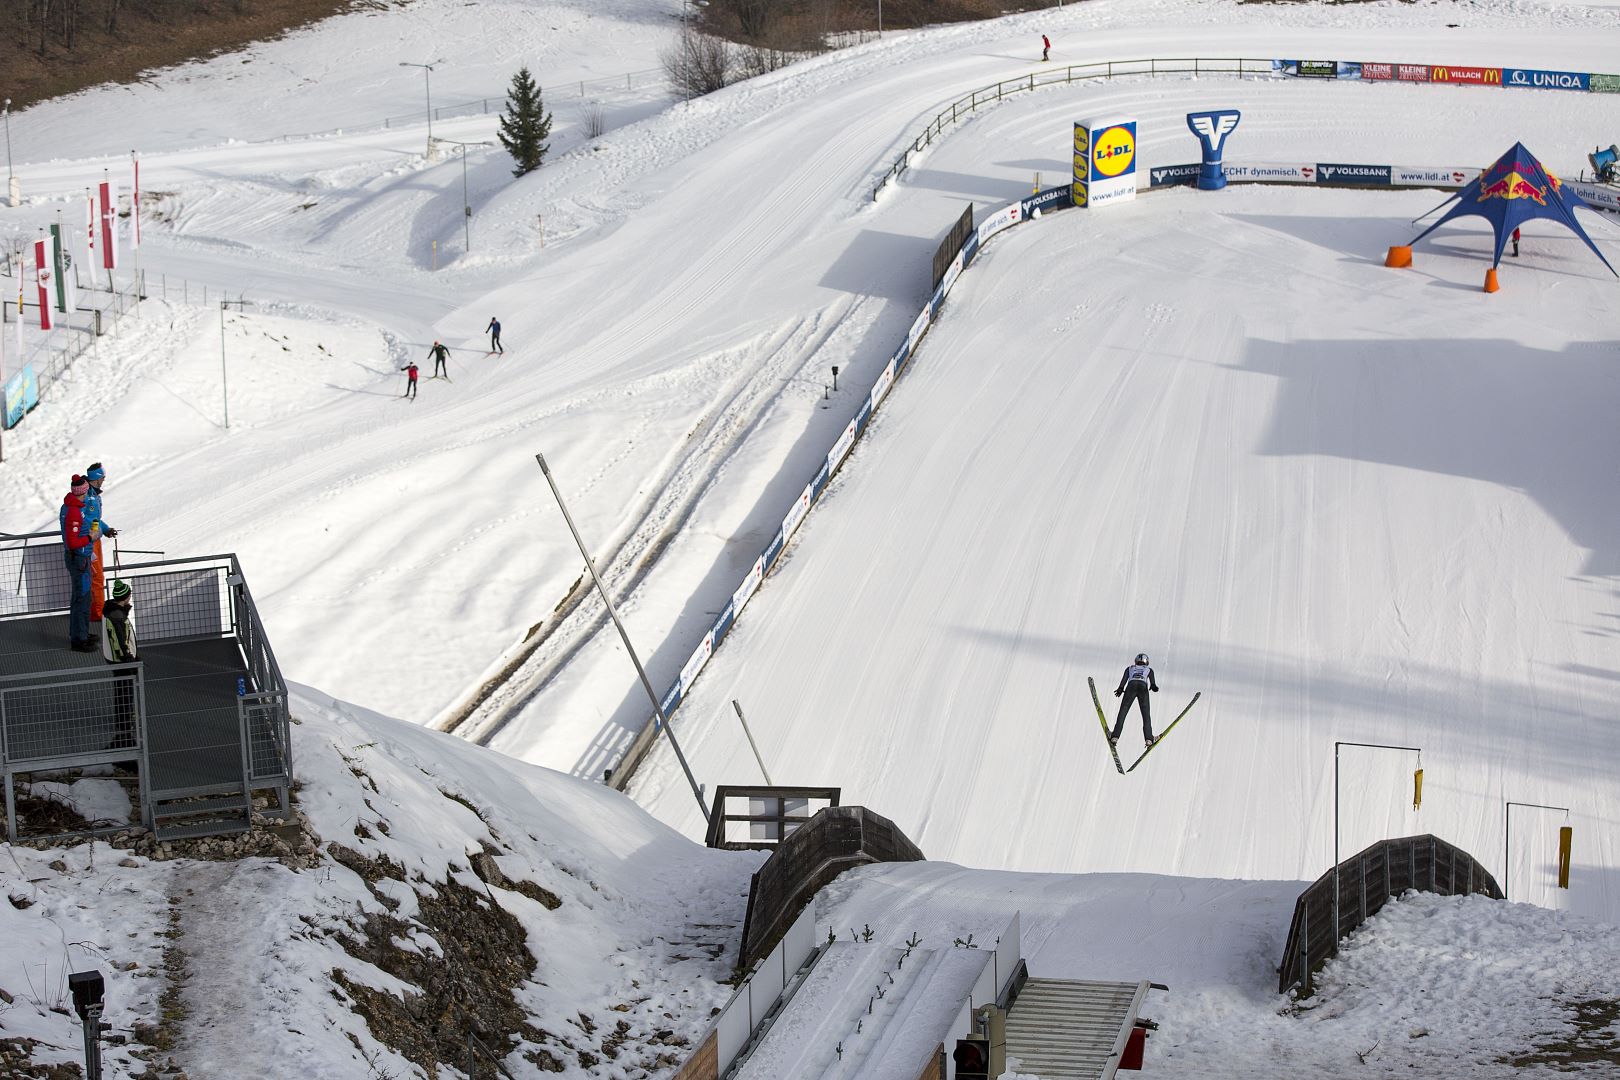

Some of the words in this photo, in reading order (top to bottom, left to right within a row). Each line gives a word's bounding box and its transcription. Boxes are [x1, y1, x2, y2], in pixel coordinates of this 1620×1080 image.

[1363, 64, 1391, 72] KLEINE
[1399, 65, 1426, 73] KLEINE
[1451, 71, 1481, 79] VILLACH
[1533, 73, 1581, 88] UNIQA
[1168, 167, 1202, 177] VOLKSB
[1223, 167, 1247, 176] ECHT
[1251, 167, 1300, 178] dynamisch.
[1336, 167, 1388, 177] VOLKSBANK
[1400, 172, 1450, 182] www.lidl.at
[1092, 186, 1135, 201] www.lidl.at
